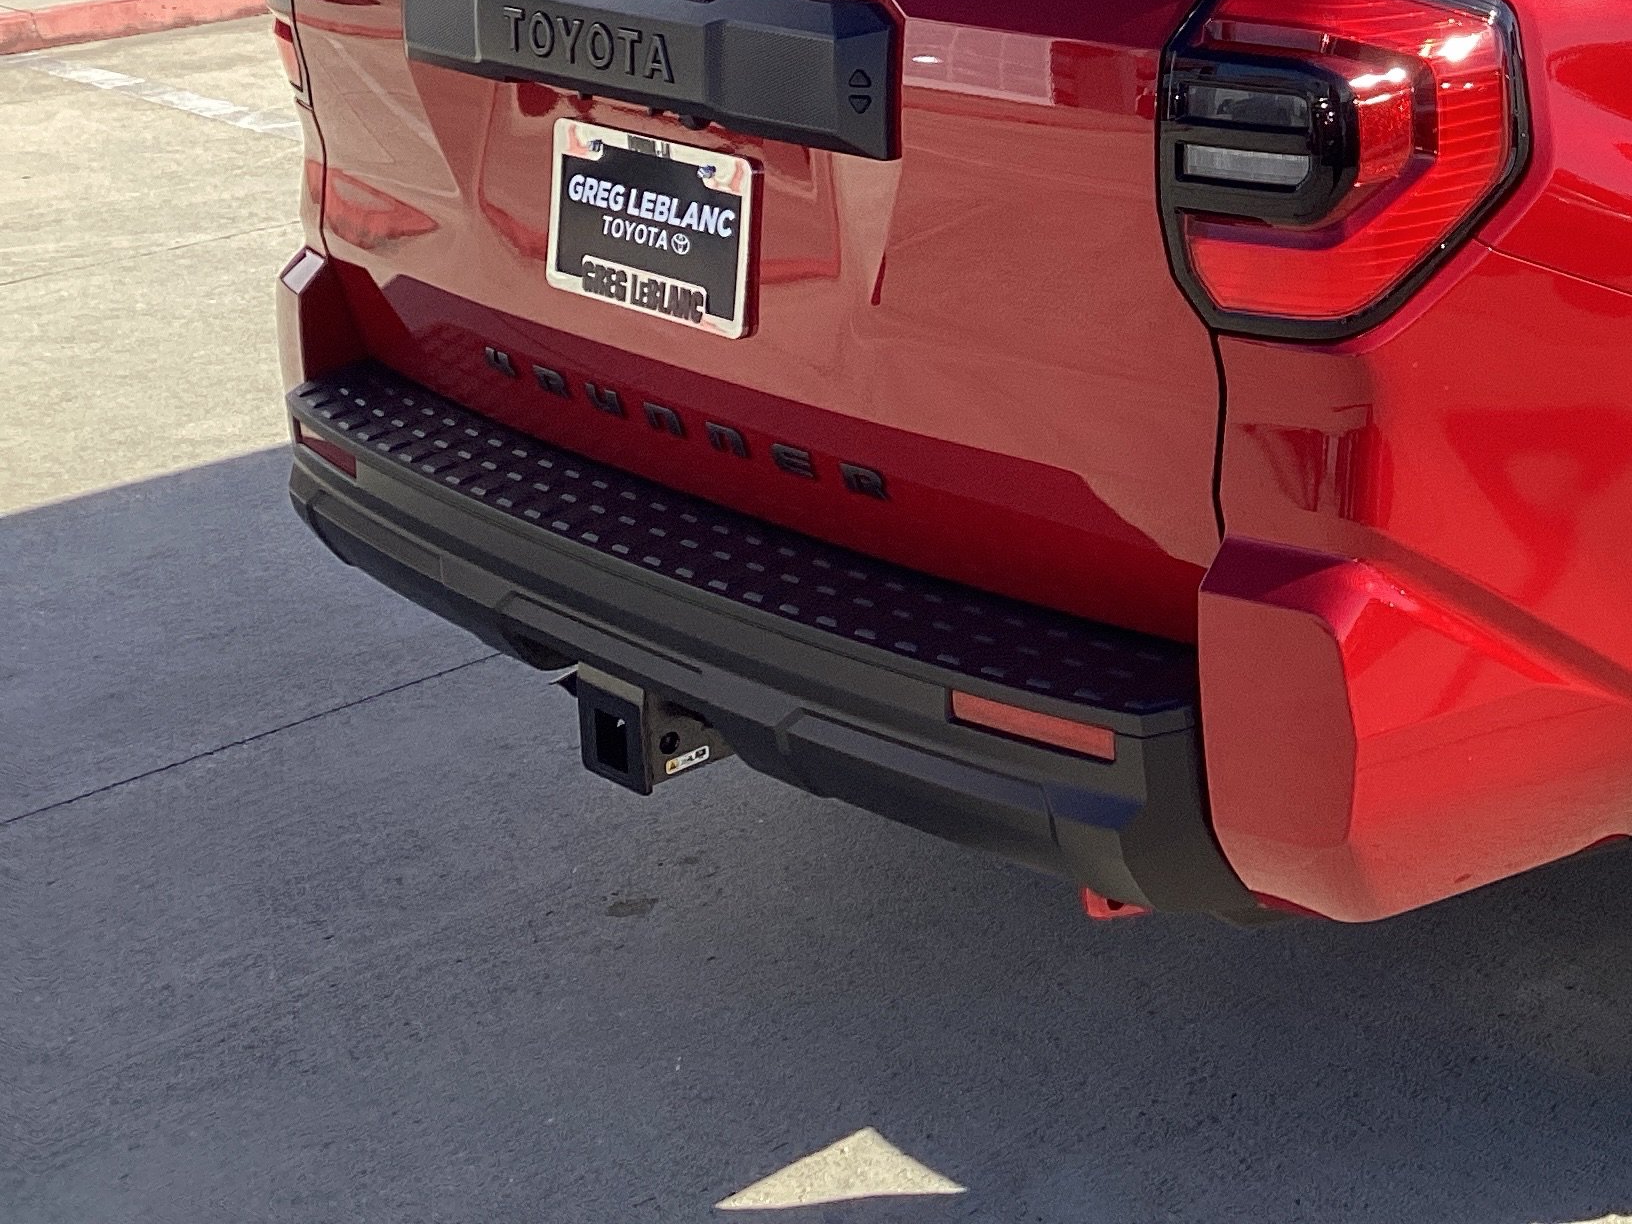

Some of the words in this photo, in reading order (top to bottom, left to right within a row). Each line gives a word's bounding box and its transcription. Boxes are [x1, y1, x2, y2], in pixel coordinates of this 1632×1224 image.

[502, 6, 675, 84] TOYOTA
[568, 173, 625, 211] GREG
[627, 188, 736, 238] LEBLANC
[602, 215, 668, 251] TOYOTA
[581, 260, 628, 301] GREG
[485, 346, 888, 500] 4RUNNER
